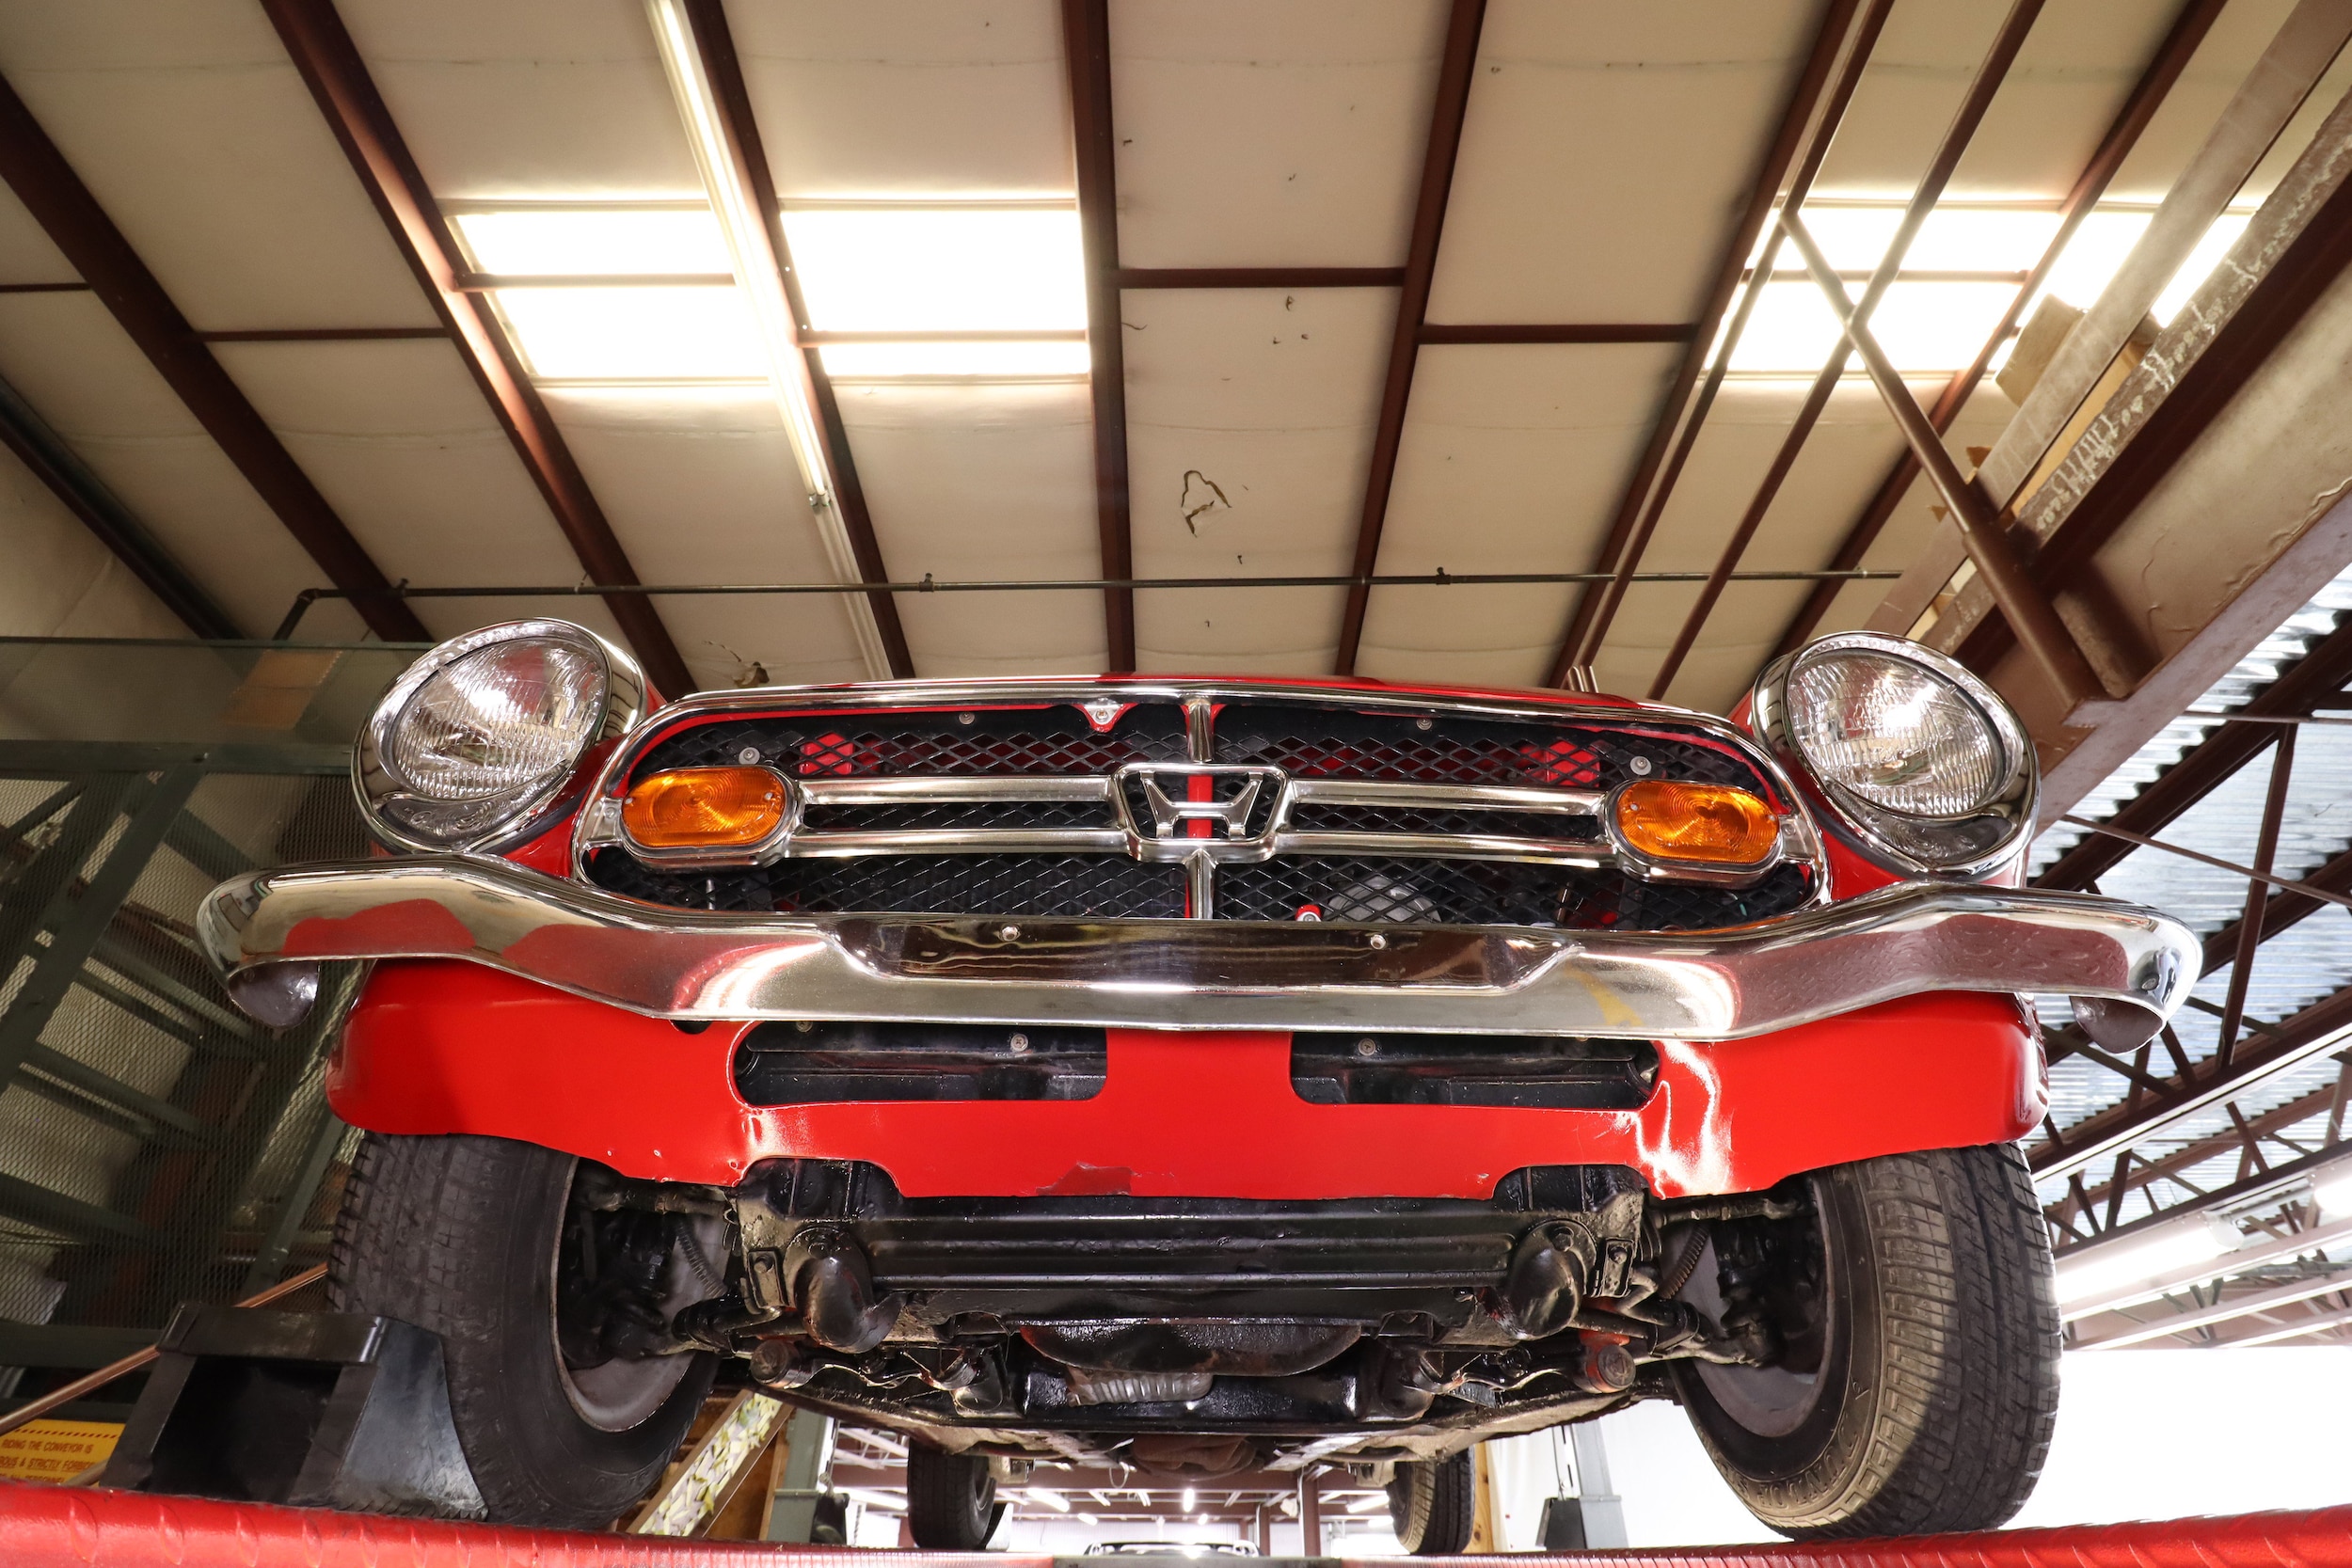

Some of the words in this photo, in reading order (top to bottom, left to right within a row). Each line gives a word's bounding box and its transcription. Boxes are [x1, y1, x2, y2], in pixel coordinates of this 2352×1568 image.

[2, 1439, 26, 1449] RIDING
[29, 1440, 43, 1450] THE
[43, 1441, 85, 1453] CONVEYOR
[84, 1444, 94, 1454] IS
[28, 1458, 62, 1469] STRICTLY
